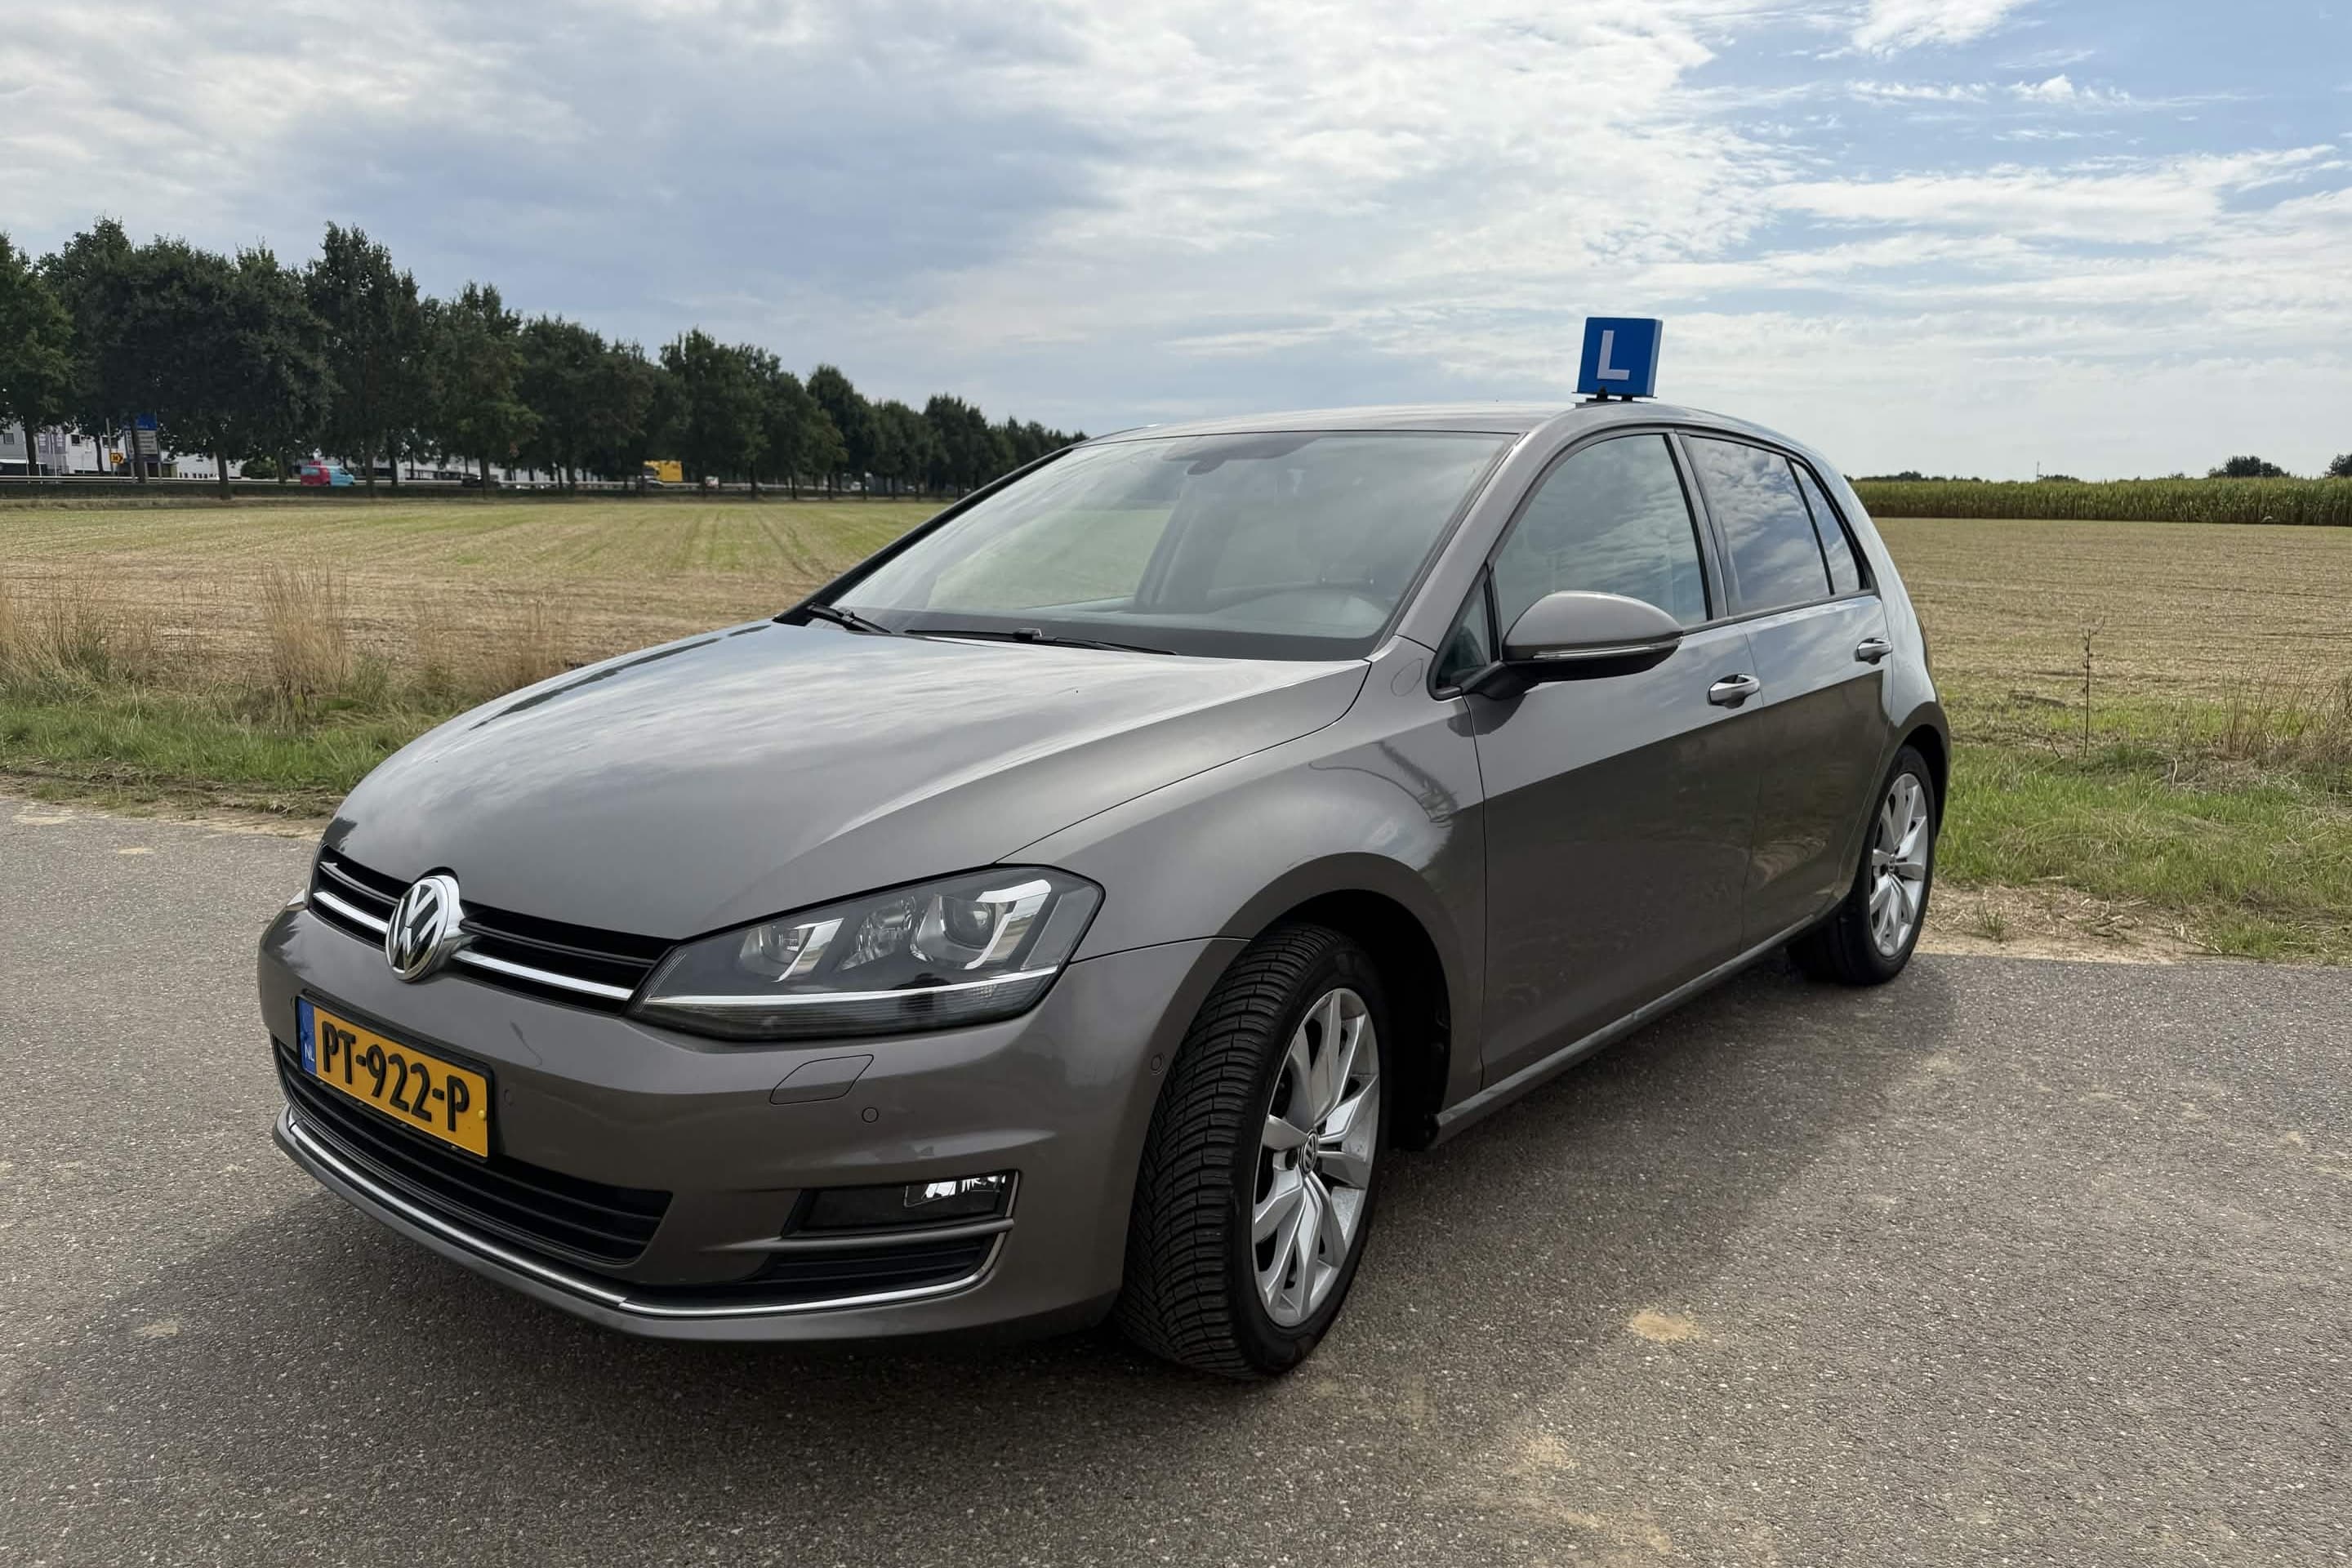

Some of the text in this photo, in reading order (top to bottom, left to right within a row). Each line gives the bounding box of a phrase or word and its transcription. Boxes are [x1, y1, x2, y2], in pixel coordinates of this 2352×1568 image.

[1597, 330, 1630, 381] L
[388, 879, 448, 977] VW
[304, 1021, 470, 1132] NL PT-922-P
